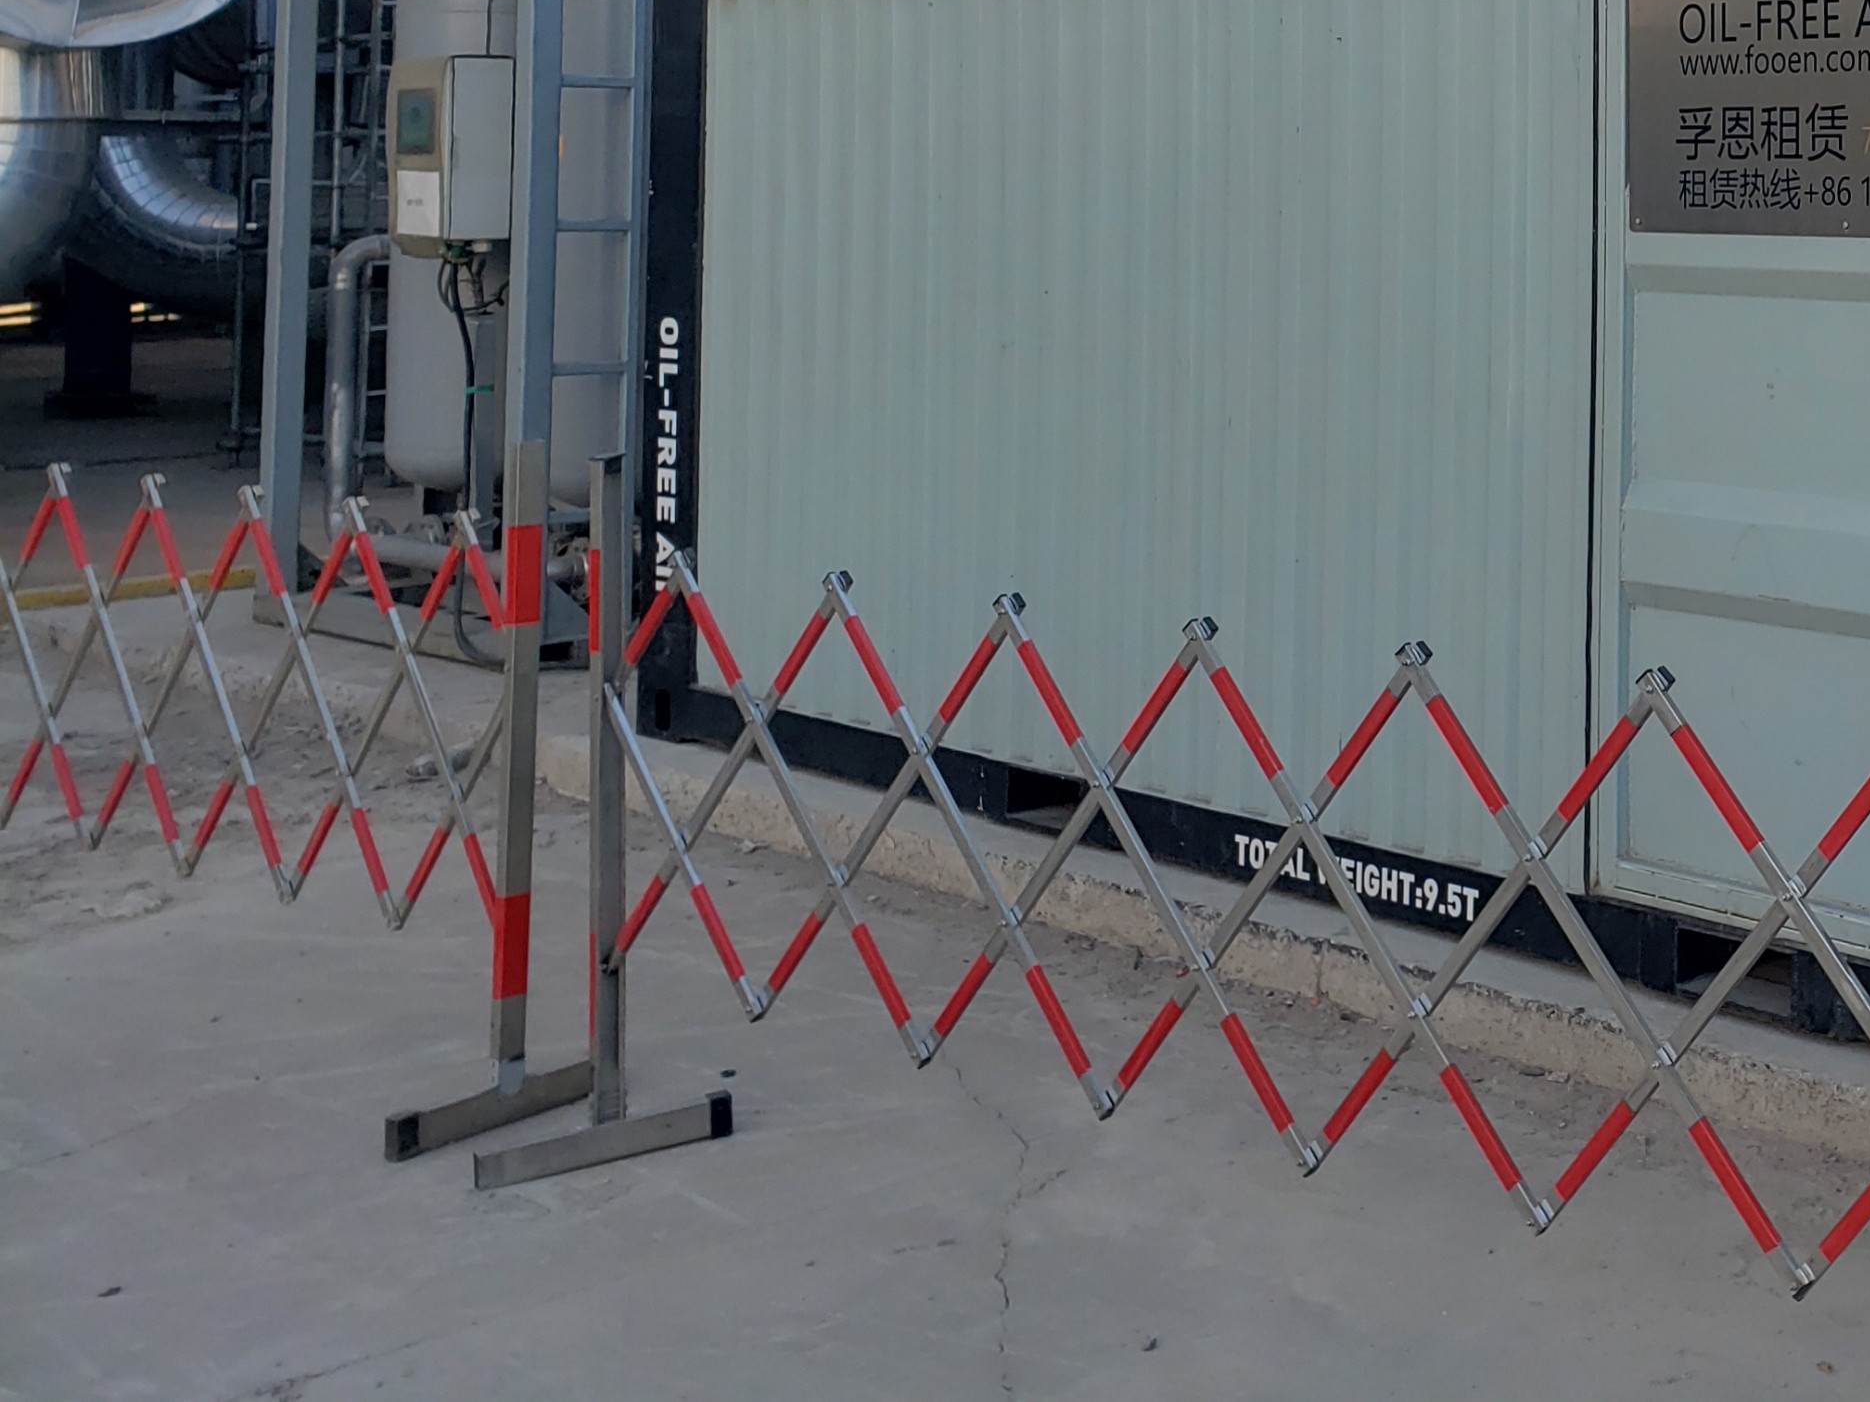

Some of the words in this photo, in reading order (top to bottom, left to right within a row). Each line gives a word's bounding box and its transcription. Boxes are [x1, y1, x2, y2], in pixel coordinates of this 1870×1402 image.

[1679, 0, 1841, 44] OIL-FREE
[1675, 103, 1849, 163] 孚恩租赁
[656, 316, 679, 525] OIL-FREE
[655, 530, 675, 592] AI
